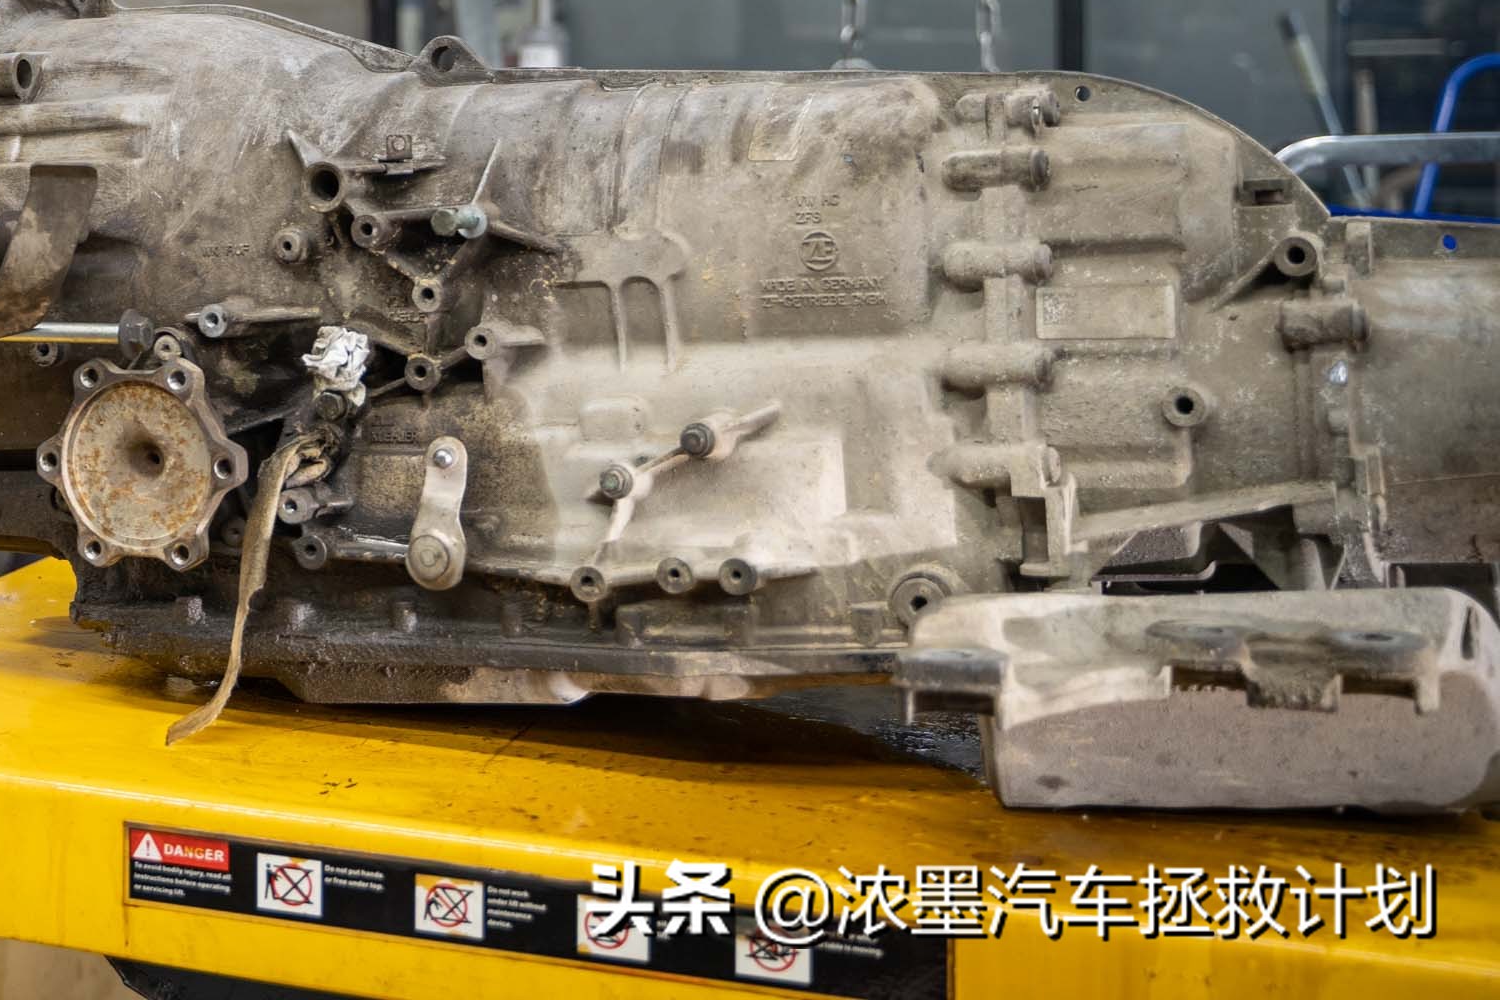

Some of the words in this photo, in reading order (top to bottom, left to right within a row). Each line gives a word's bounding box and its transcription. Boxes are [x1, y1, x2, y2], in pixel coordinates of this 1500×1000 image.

[759, 278, 797, 292] MADE
[820, 276, 885, 291] GERMANY
[163, 842, 225, 863] DANGER
